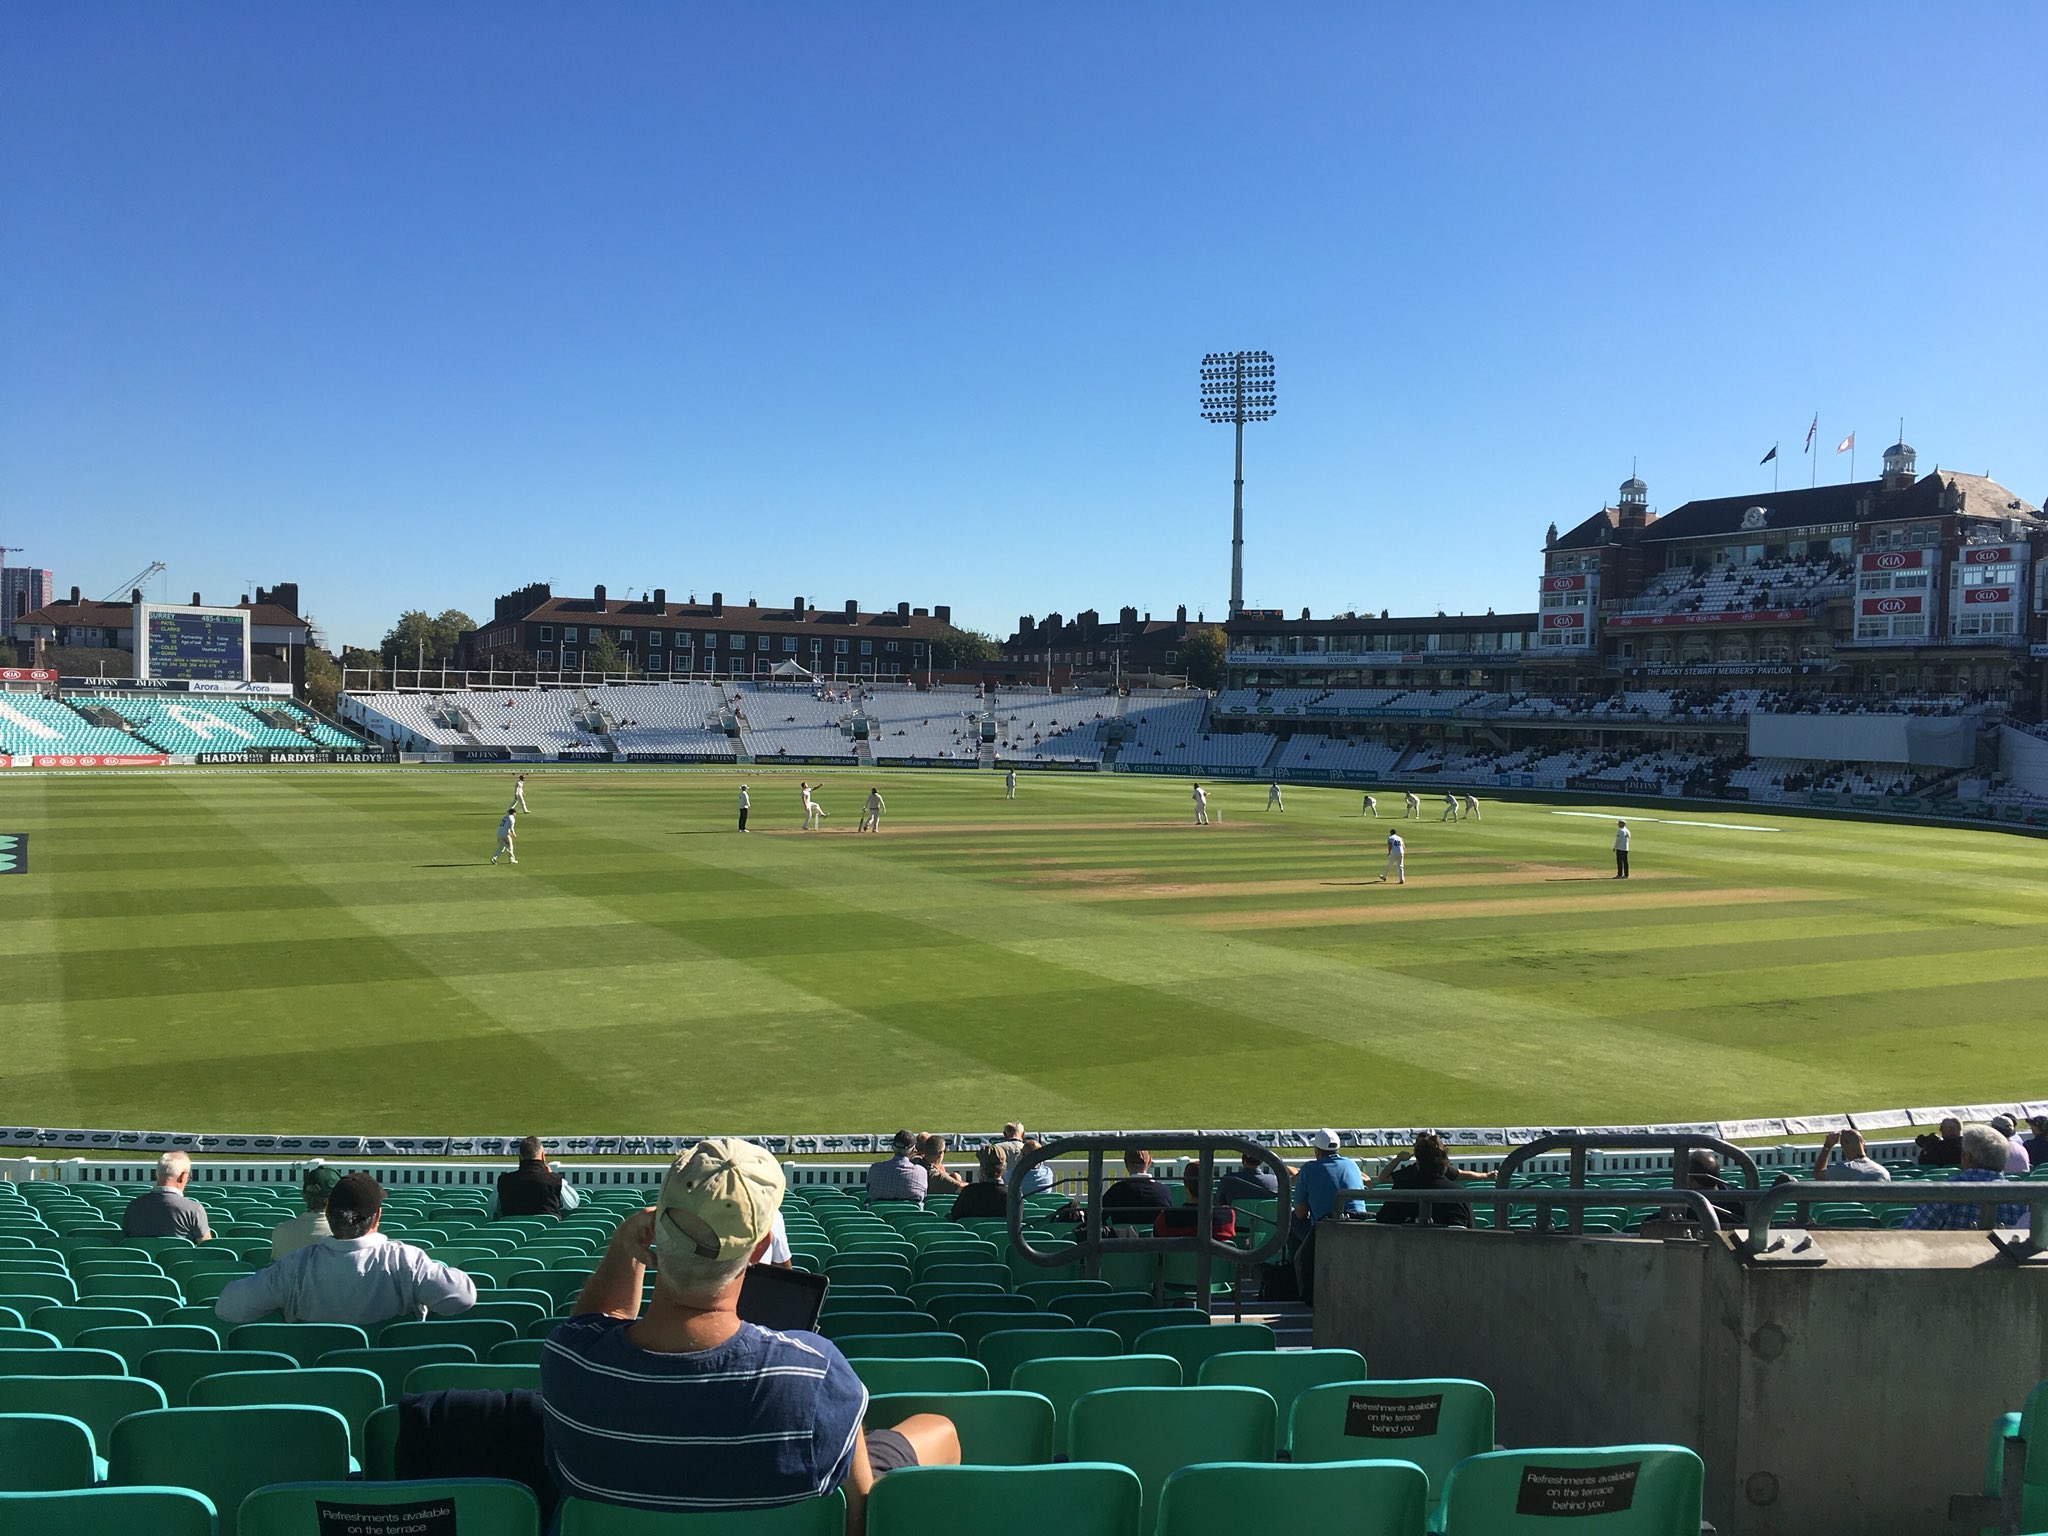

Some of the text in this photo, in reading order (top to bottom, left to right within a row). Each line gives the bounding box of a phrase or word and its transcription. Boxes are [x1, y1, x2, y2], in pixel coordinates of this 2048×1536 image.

[1718, 666, 1757, 674] MEMBERS'
[1757, 666, 1792, 674] PAVILION
[193, 683, 219, 691] Arora
[246, 684, 270, 692] Arora
[1338, 707, 1350, 715] IPA
[1420, 709, 1431, 717] IPA
[202, 753, 248, 763] HARDYS
[270, 753, 315, 763] HARDYS
[336, 754, 382, 763] HARDYS
[1115, 763, 1131, 772] IPA
[1134, 765, 1165, 773] GREENE
[1166, 766, 1187, 774] KING
[1190, 765, 1205, 775] IPA
[1235, 767, 1251, 775] SPENT
[1274, 768, 1291, 778] IPA
[1329, 769, 1346, 779] IPA
[1352, 1401, 1437, 1412] Refreshments available
[1381, 1414, 1393, 1422] the
[1395, 1414, 1421, 1422] terrace
[1372, 1424, 1414, 1434] behind you
[1527, 1471, 1635, 1485] Refreshments available
[1547, 1486, 1614, 1497] on the terrace
[1552, 1500, 1605, 1511] behind you
[322, 1508, 450, 1522] Refreshments available
[347, 1523, 426, 1535] on the terrace
